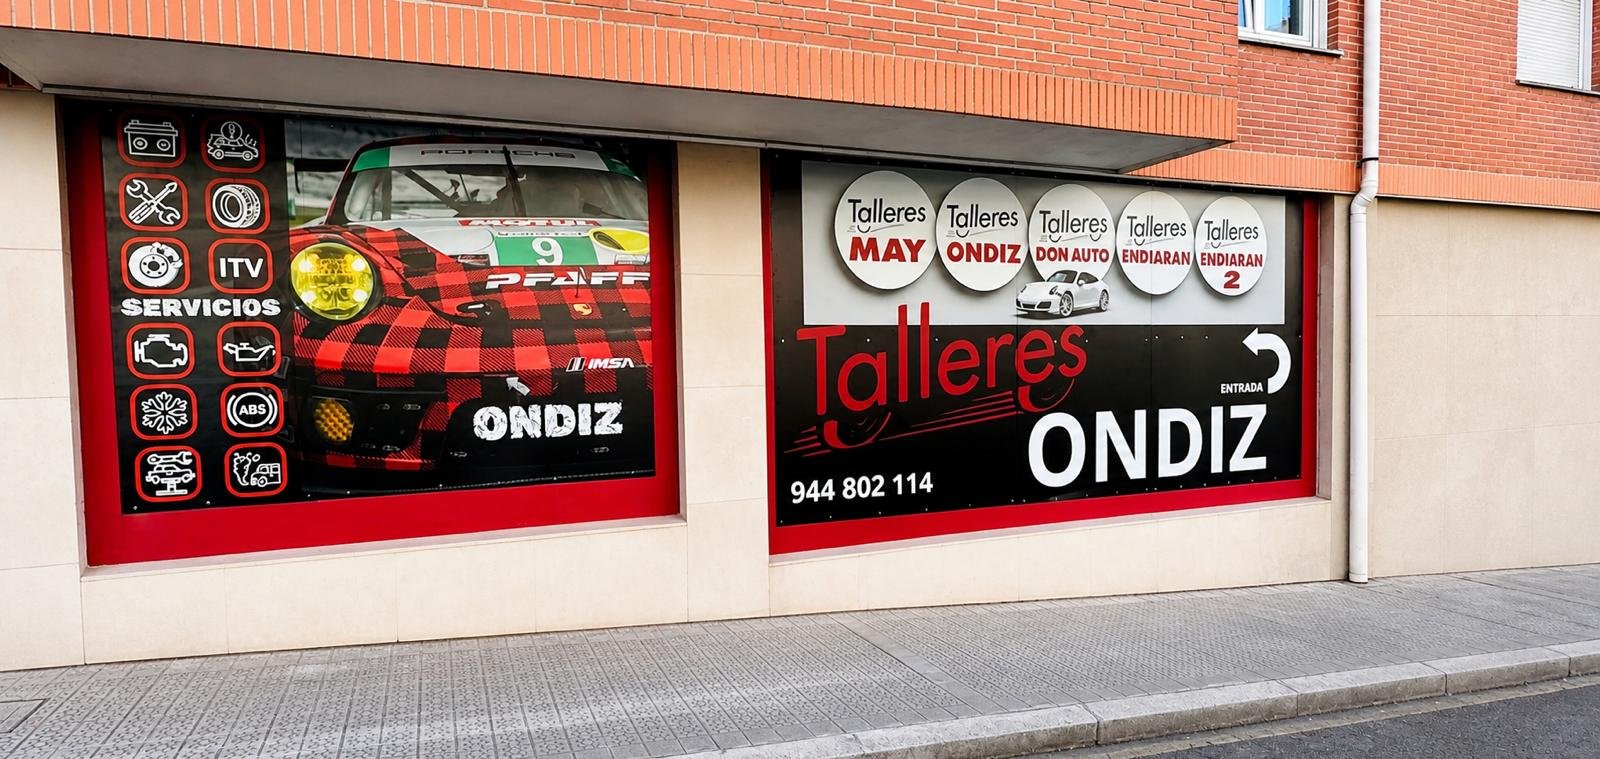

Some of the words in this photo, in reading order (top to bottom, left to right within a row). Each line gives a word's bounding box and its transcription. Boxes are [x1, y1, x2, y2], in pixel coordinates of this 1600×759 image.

[847, 198, 926, 223] Talleres
[946, 204, 1019, 228] Talleres
[1039, 209, 1108, 234] Talleres
[1126, 215, 1187, 238] Talleres
[1203, 218, 1259, 241] Talleres
[531, 237, 564, 266] 9
[849, 236, 927, 262] MAY
[946, 241, 1022, 264] ONDIZ
[1036, 246, 1069, 262] DON
[1071, 248, 1110, 263] AUTO
[1122, 248, 1191, 266] ENDIARAN
[1200, 252, 1263, 267] ENDIARAN
[219, 257, 264, 278] ITV
[485, 271, 650, 290] PFAFF
[1223, 271, 1240, 289] 2
[120, 298, 281, 317] SERVICIOS
[588, 357, 635, 369] IMSA
[796, 302, 1087, 415] Talleres
[1220, 382, 1264, 394] ENTRADA
[238, 404, 267, 416] ABS
[472, 401, 624, 441] ONDIZ
[1028, 404, 1267, 488] ONDIZ
[790, 479, 835, 504] 944
[842, 474, 885, 500] 802
[892, 472, 934, 495] 114
